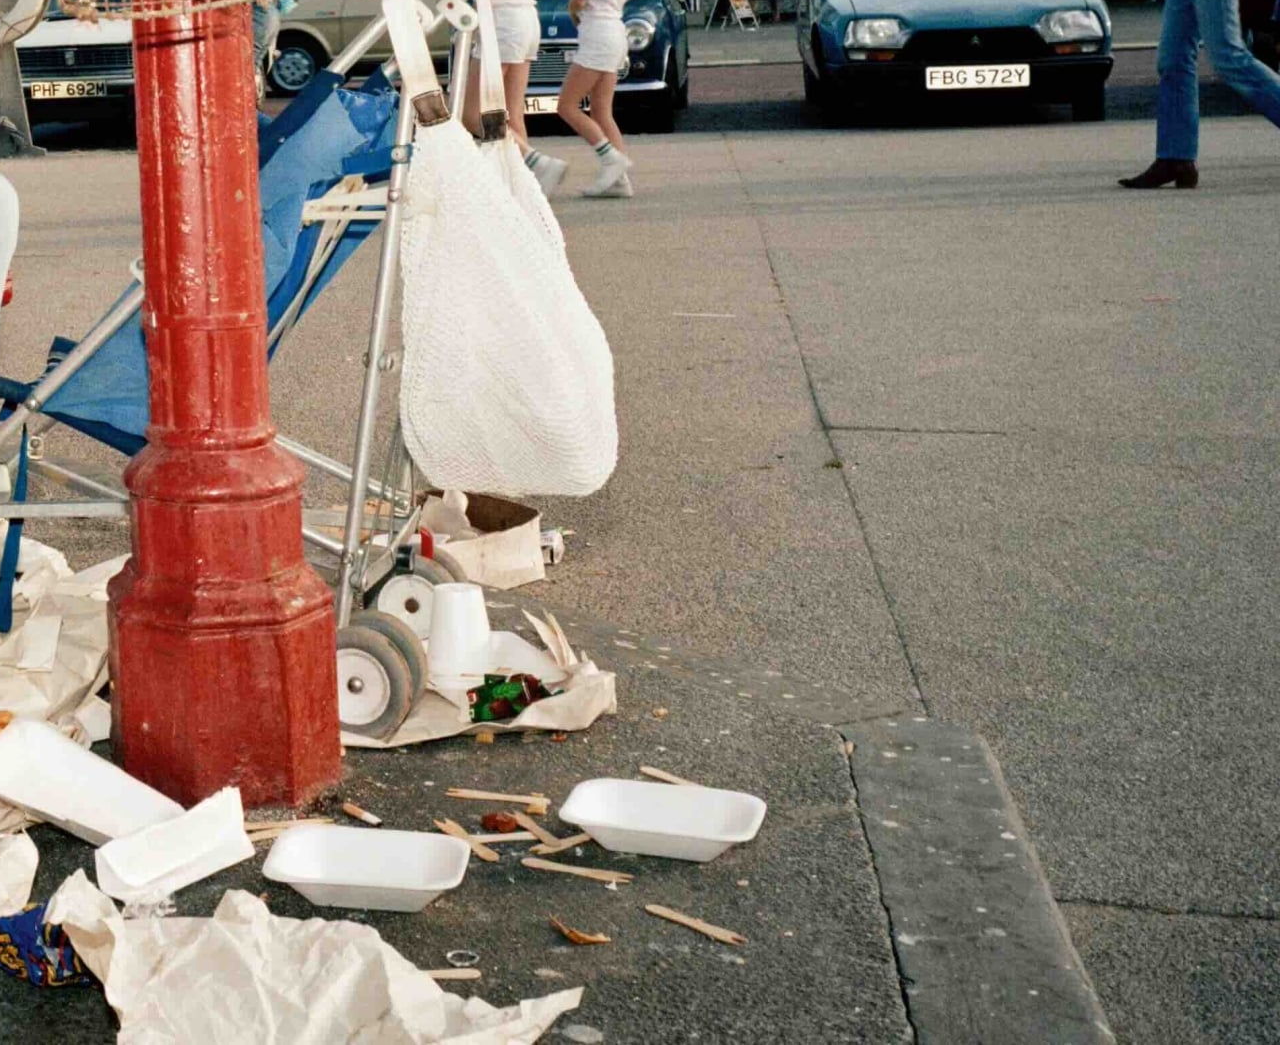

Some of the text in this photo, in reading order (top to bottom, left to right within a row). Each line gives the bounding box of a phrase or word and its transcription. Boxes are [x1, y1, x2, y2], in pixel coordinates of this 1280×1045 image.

[929, 68, 1026, 85] FBG 572Y
[32, 82, 106, 97] PHF 692M
